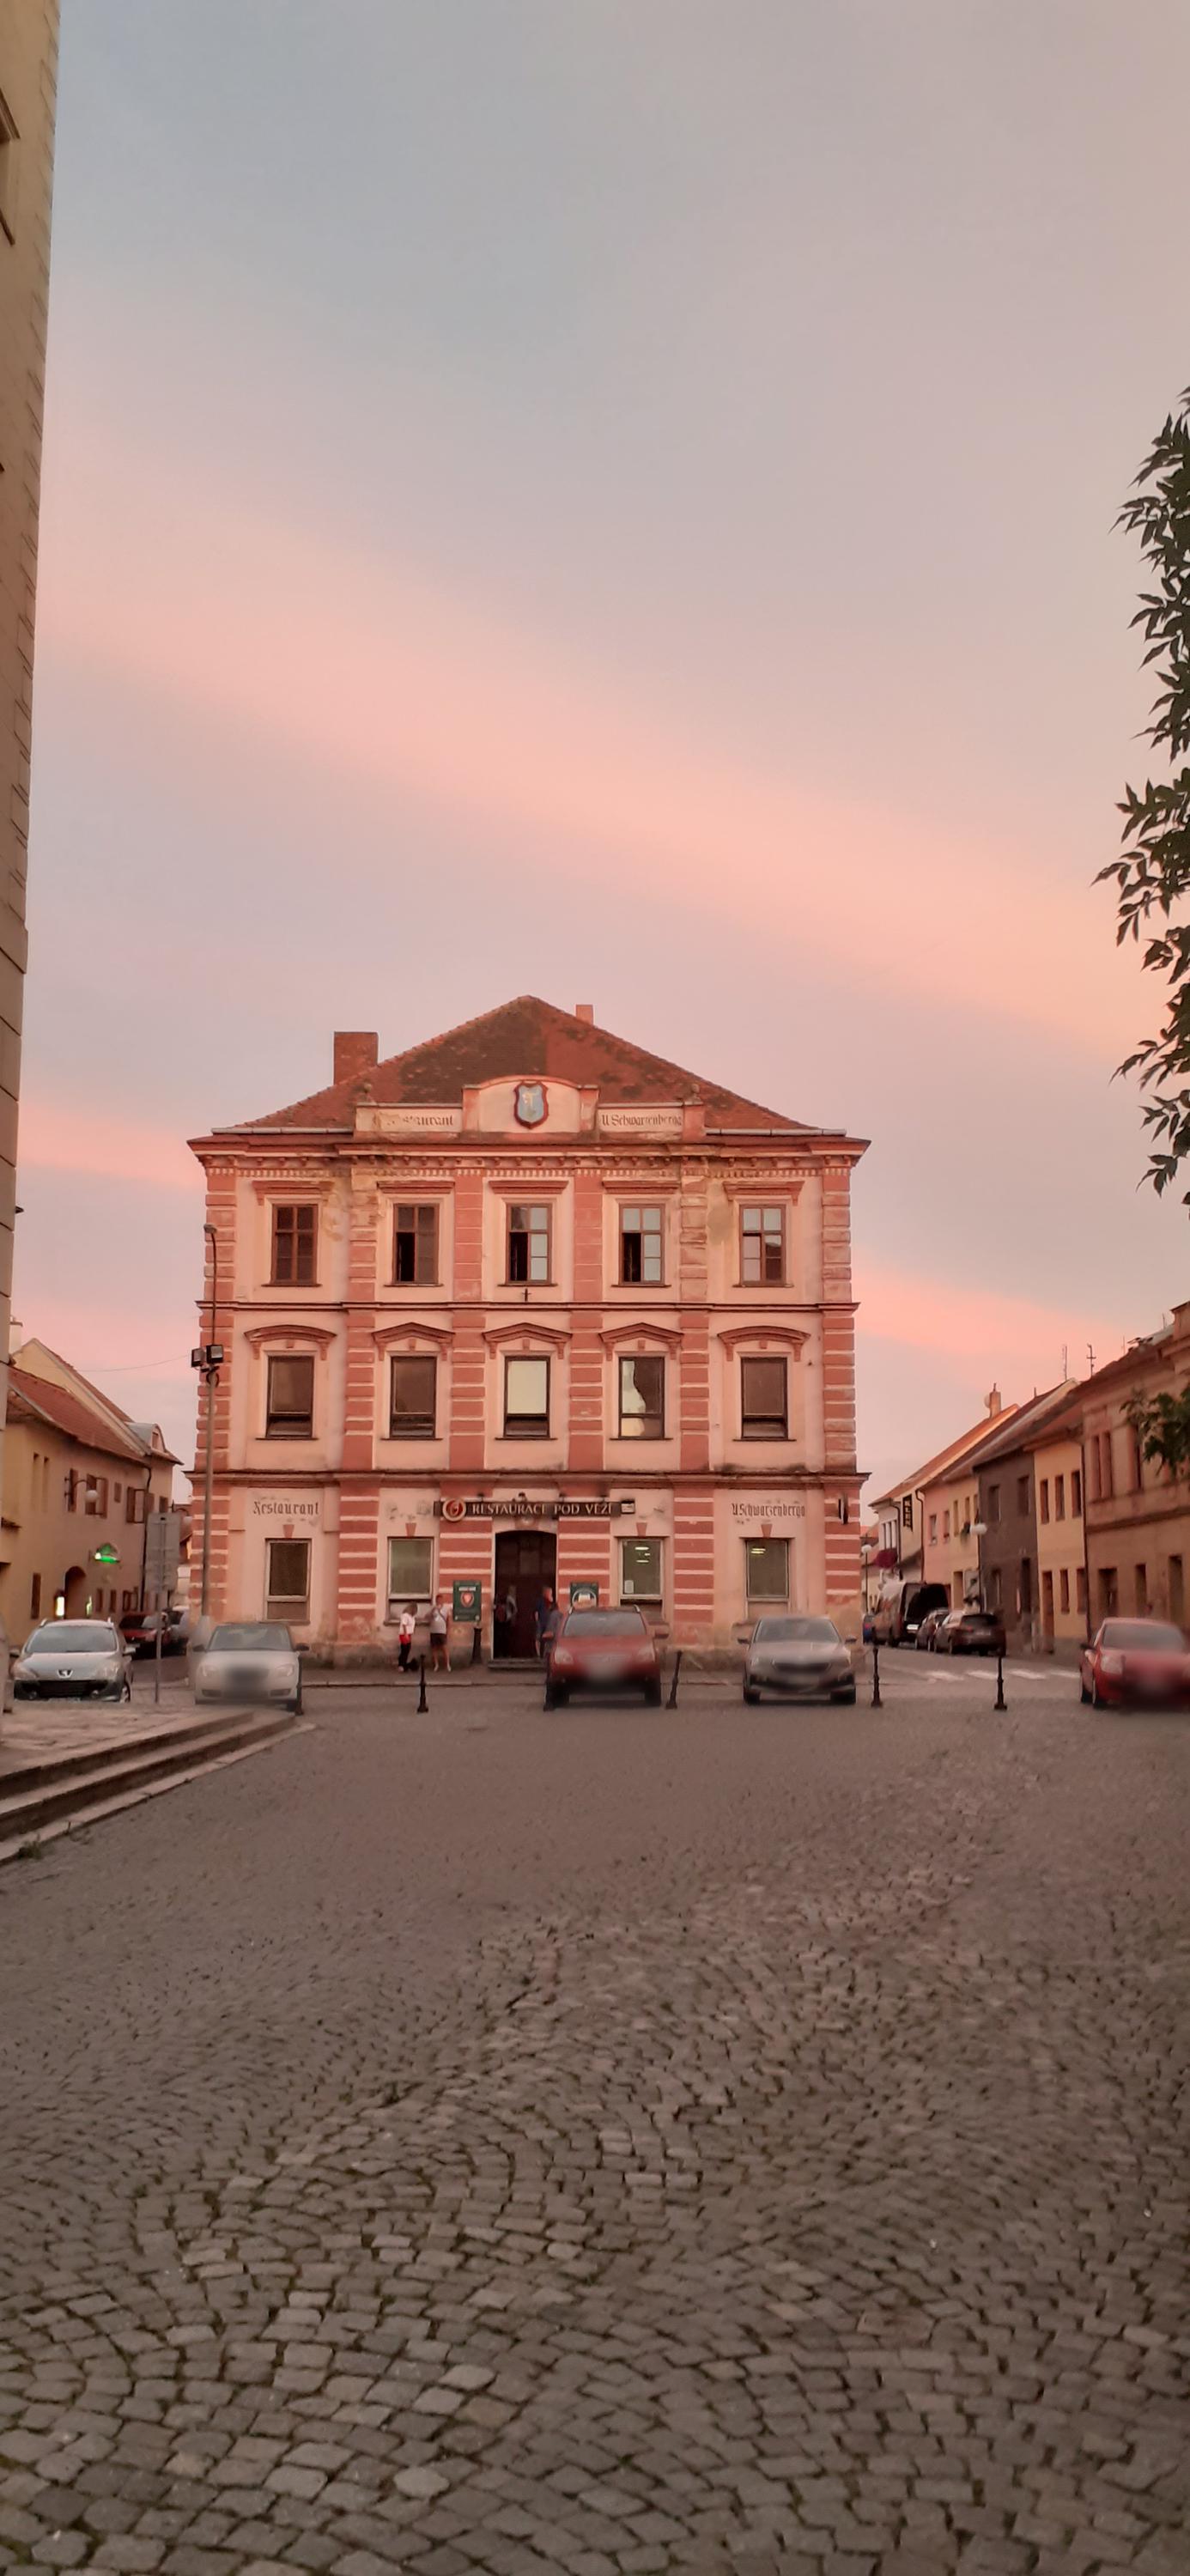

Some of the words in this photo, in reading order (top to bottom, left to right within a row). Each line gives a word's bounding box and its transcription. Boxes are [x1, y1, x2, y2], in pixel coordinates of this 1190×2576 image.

[253, 1501, 319, 1516] Restaurant
[472, 1504, 545, 1515] RESTAURACE
[555, 1504, 580, 1515] POD
